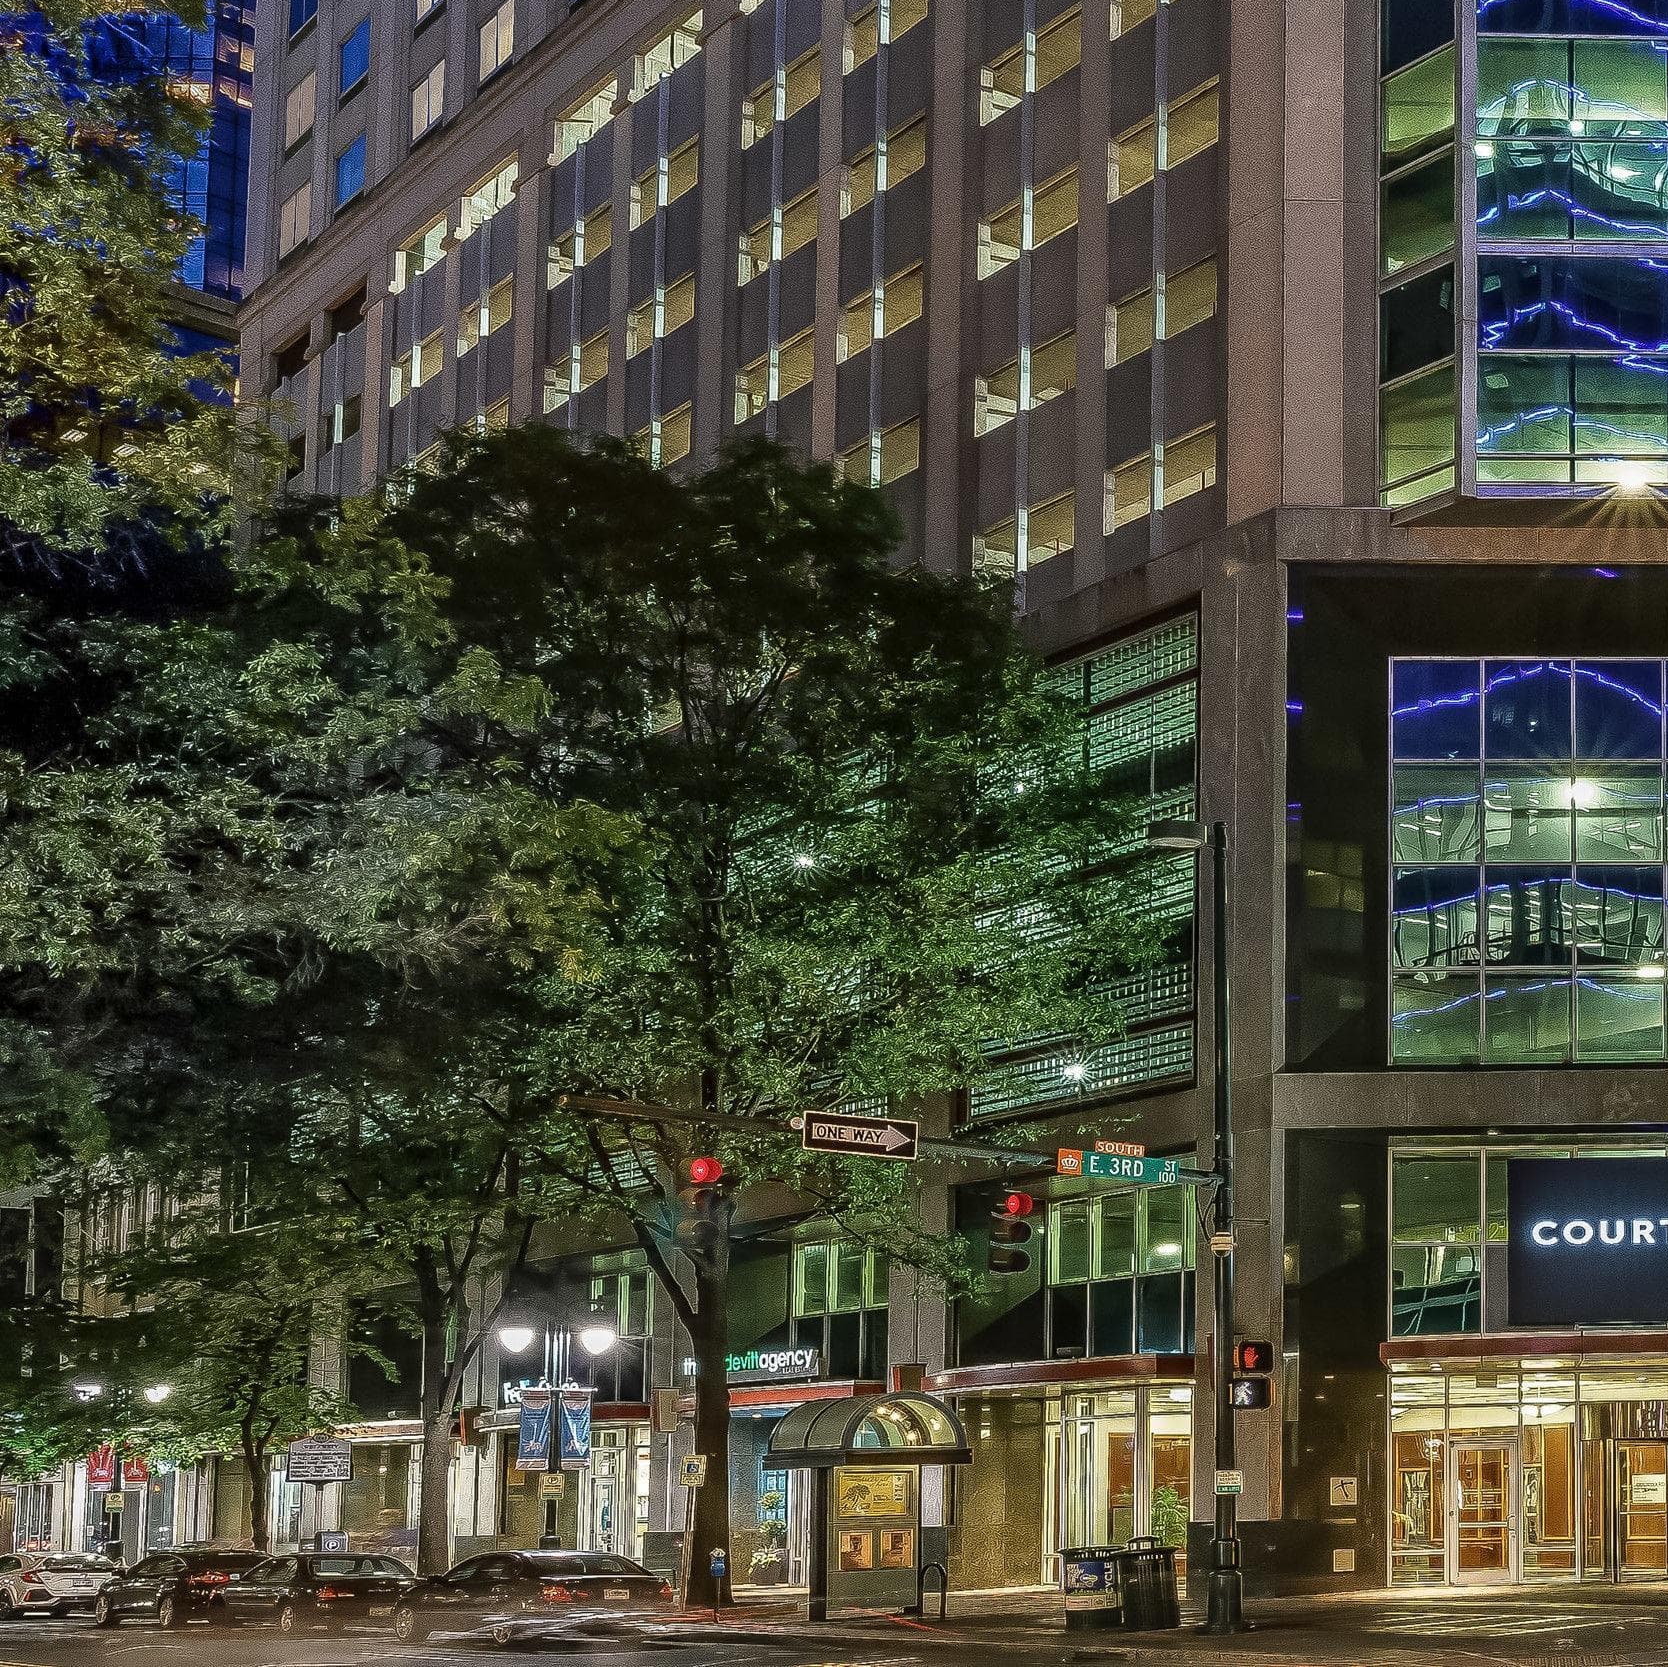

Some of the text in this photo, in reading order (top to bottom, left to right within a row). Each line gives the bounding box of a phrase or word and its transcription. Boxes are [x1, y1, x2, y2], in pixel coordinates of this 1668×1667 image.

[816, 1125, 884, 1143] ONE WAY
[1097, 1141, 1143, 1156] SOUTH
[1089, 1155, 1176, 1177] E. 3RD ST
[1158, 1171, 1176, 1183] 100
[725, 1348, 814, 1373] devittagency
